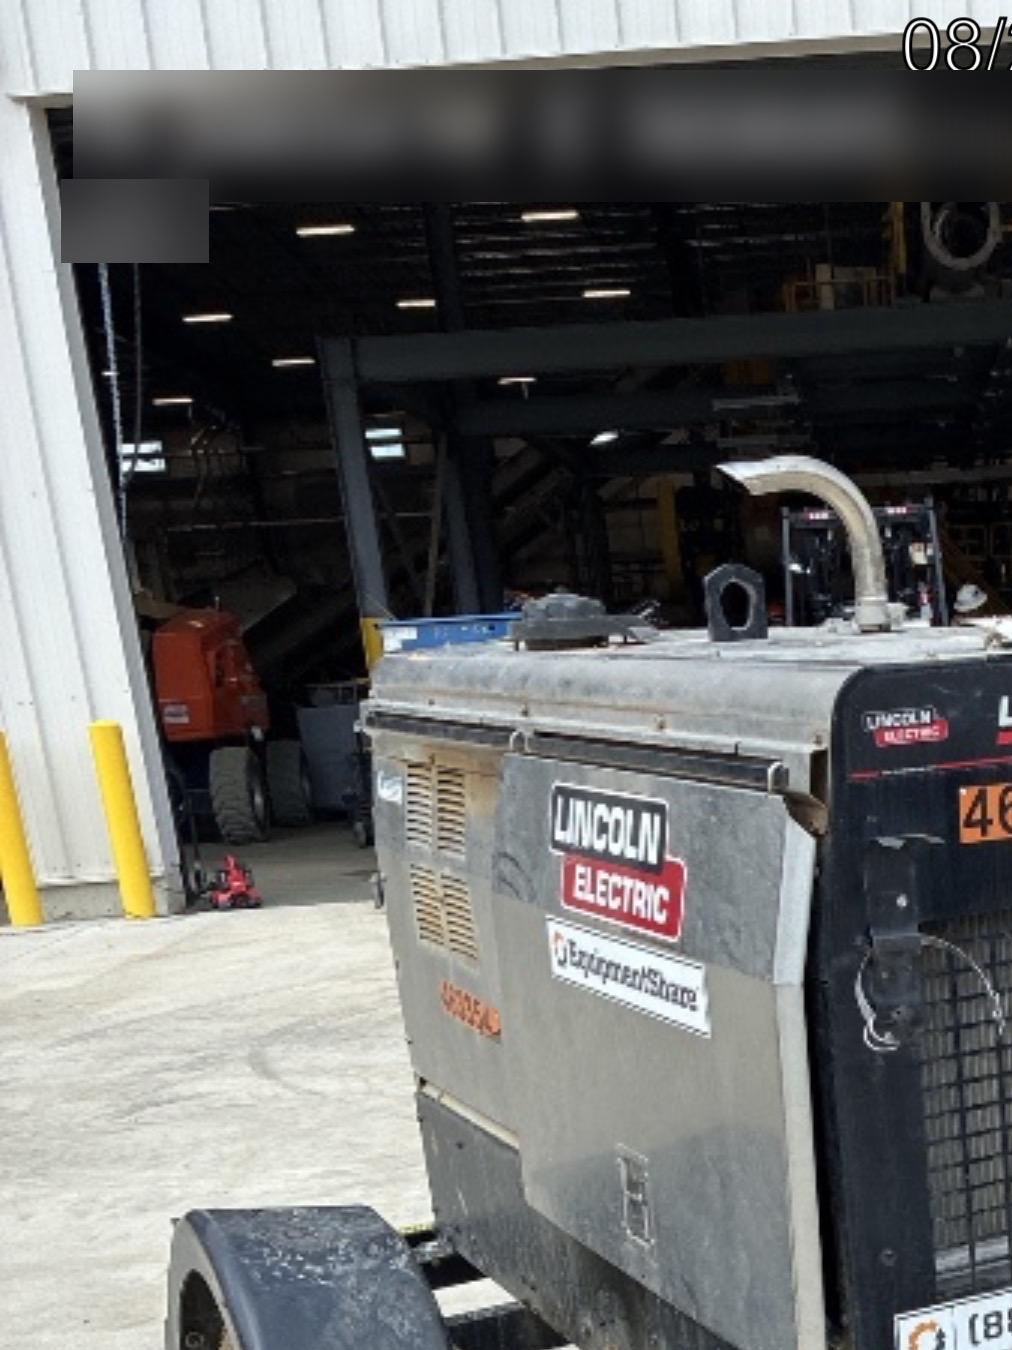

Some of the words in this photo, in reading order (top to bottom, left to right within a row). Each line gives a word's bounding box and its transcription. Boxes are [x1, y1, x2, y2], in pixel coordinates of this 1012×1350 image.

[865, 709, 932, 730] LINCOLN
[554, 794, 662, 866] LINCOLN
[573, 863, 670, 924] ELECTRIC
[567, 938, 699, 1012] EquipmentShare
